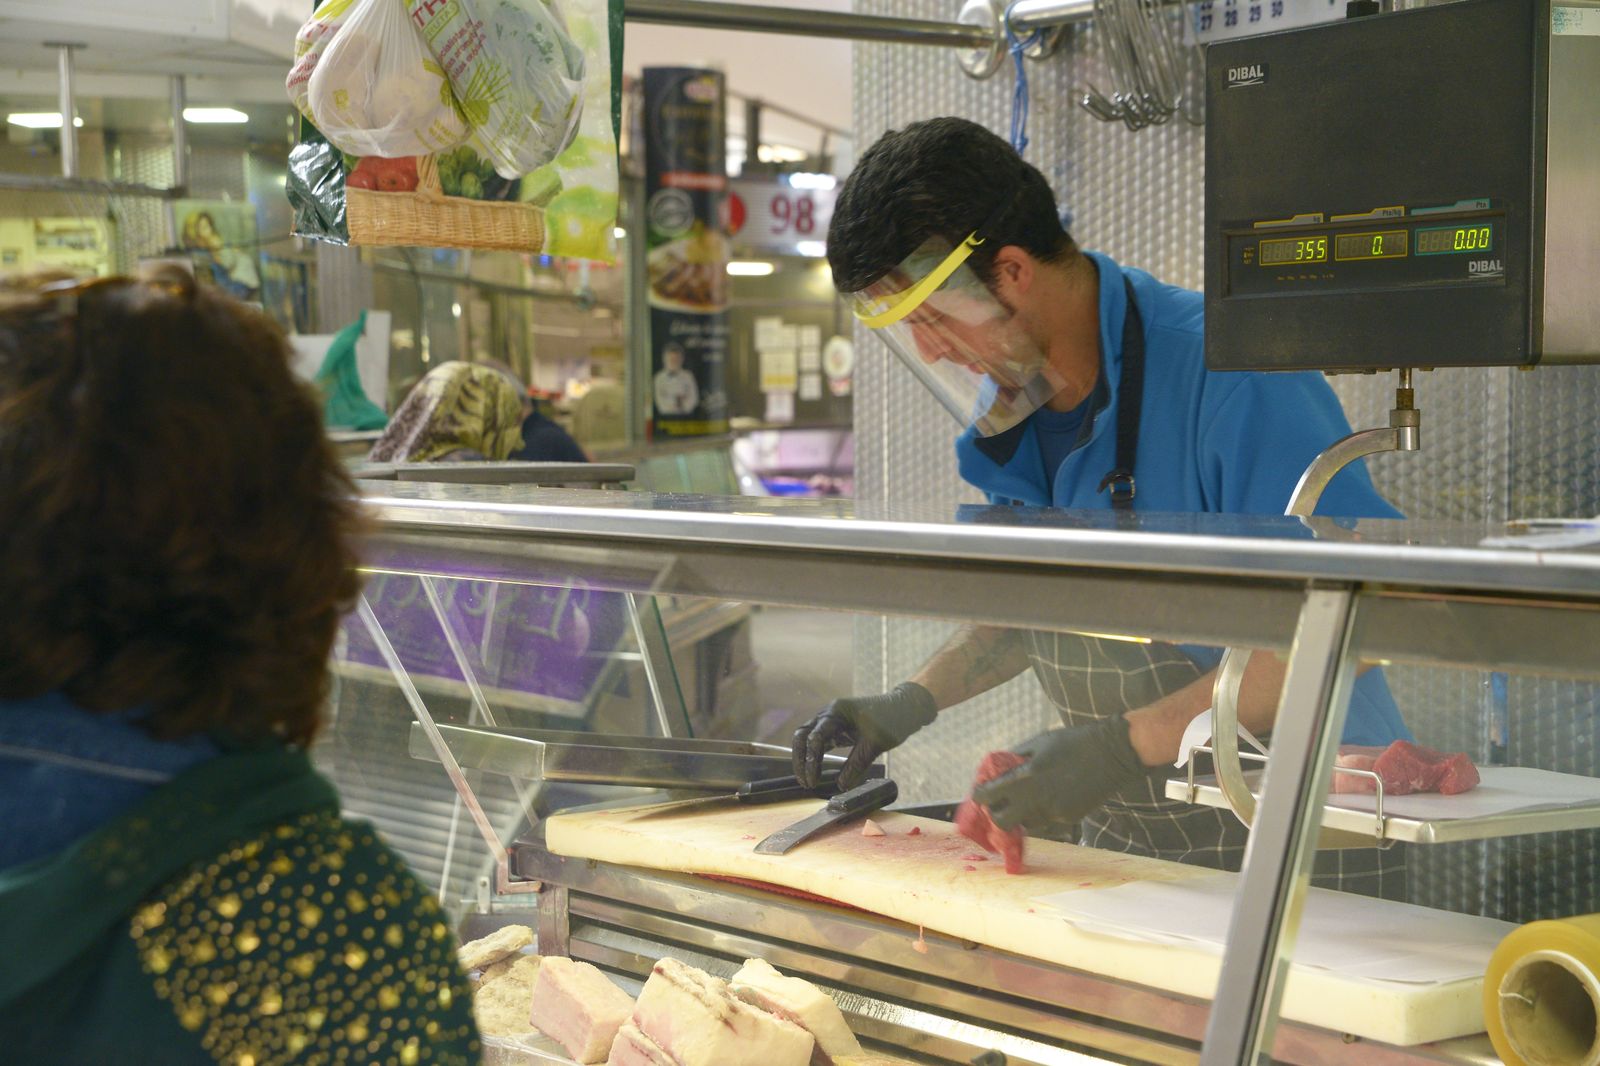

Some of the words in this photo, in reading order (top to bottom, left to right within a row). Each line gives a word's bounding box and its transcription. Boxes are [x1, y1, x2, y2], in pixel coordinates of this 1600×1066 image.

[1201, 15, 1212, 31] 27
[1225, 10, 1238, 26] 28
[1249, 5, 1261, 23] 29
[1228, 64, 1264, 82] DIBAL
[770, 192, 816, 235] 98
[1295, 239, 1327, 260] 355
[1453, 227, 1491, 251] 0.00
[1468, 259, 1503, 274] DIBAL
